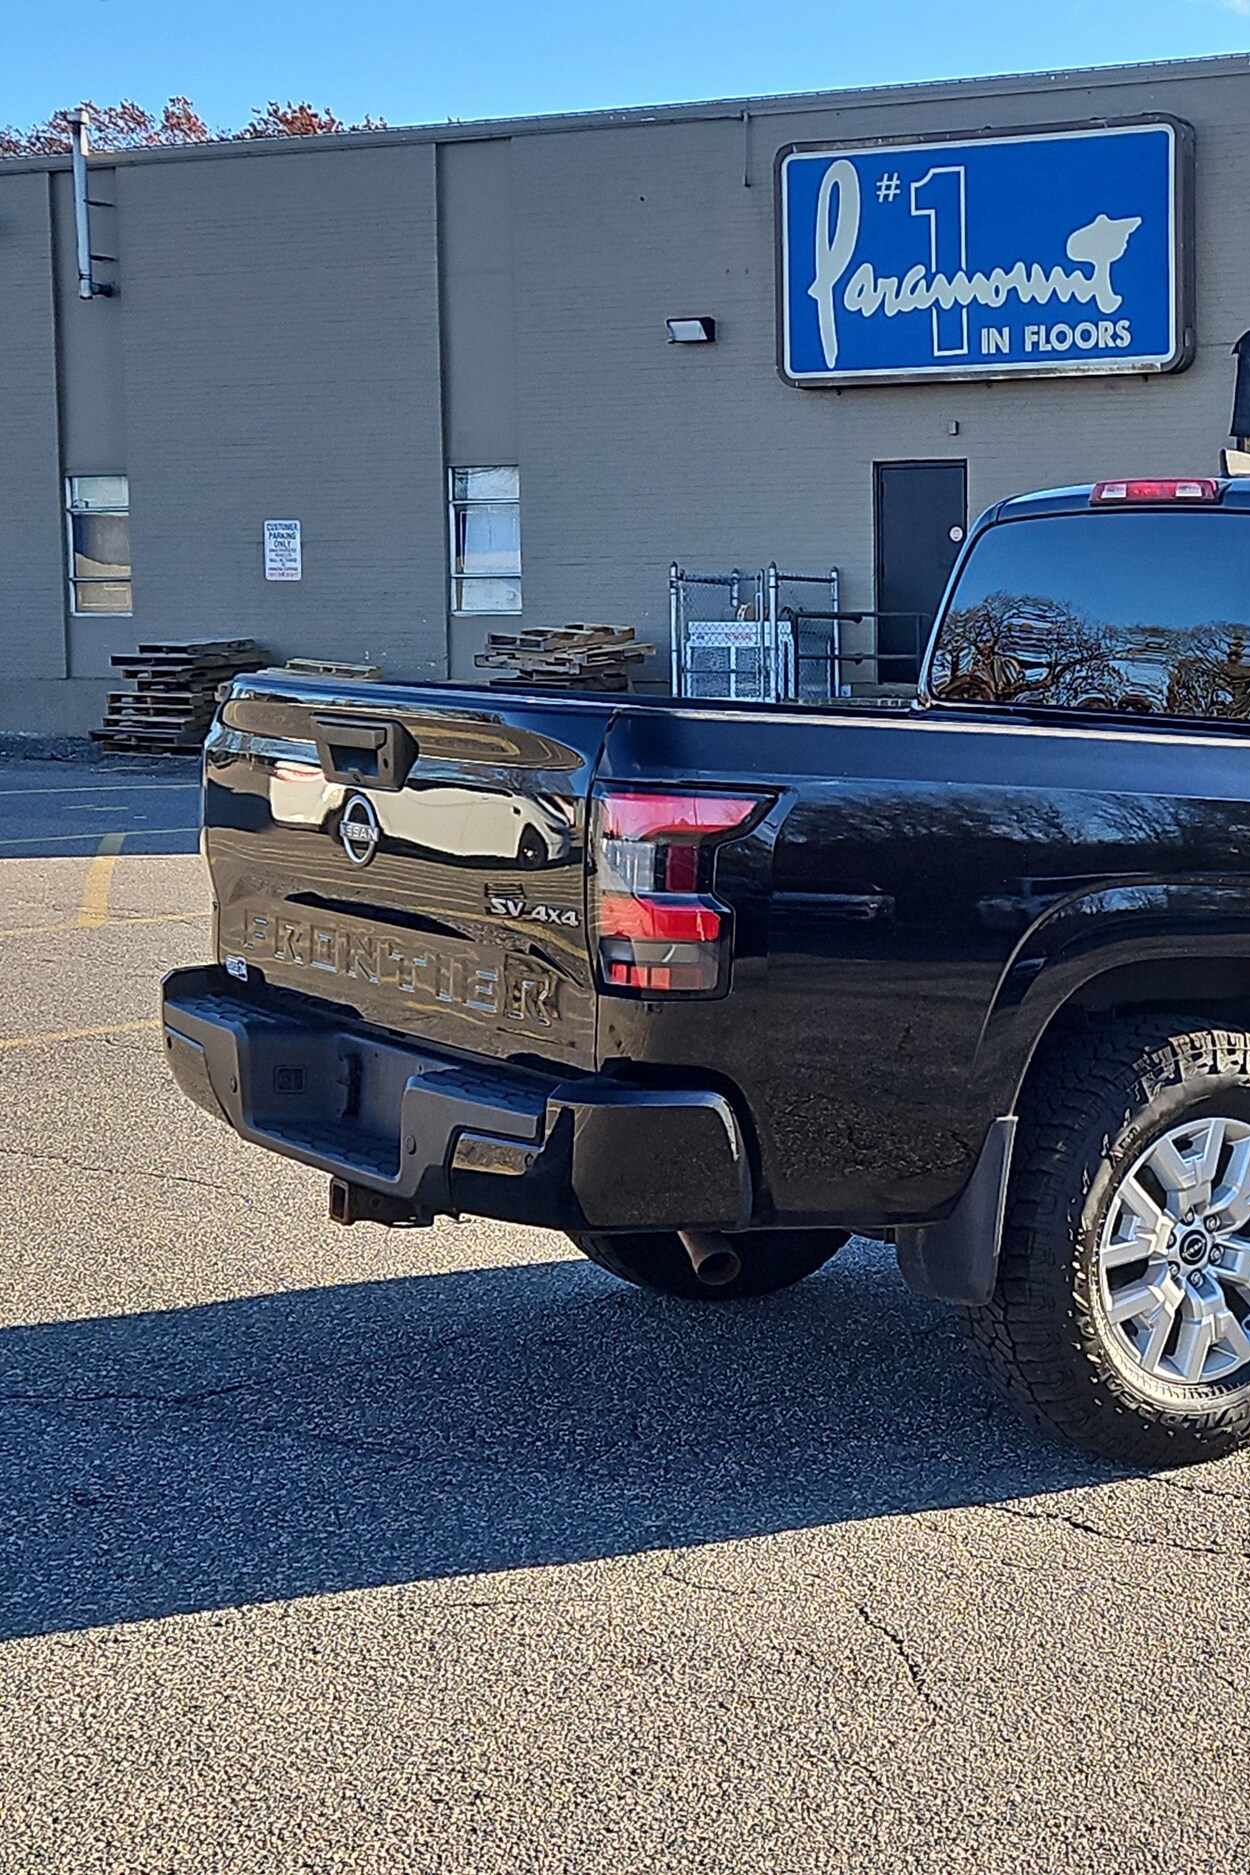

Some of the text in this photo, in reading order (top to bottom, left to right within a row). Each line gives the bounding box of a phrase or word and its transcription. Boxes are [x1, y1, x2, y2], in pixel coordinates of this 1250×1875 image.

[808, 159, 1141, 369] Paramount
[981, 320, 1131, 354] IN FLOORS
[266, 523, 298, 532] CUSTOMER
[268, 532, 297, 540] PARKING
[273, 540, 292, 548] ONLY
[490, 897, 524, 917] SV
[241, 907, 563, 1027] FRONTIER
